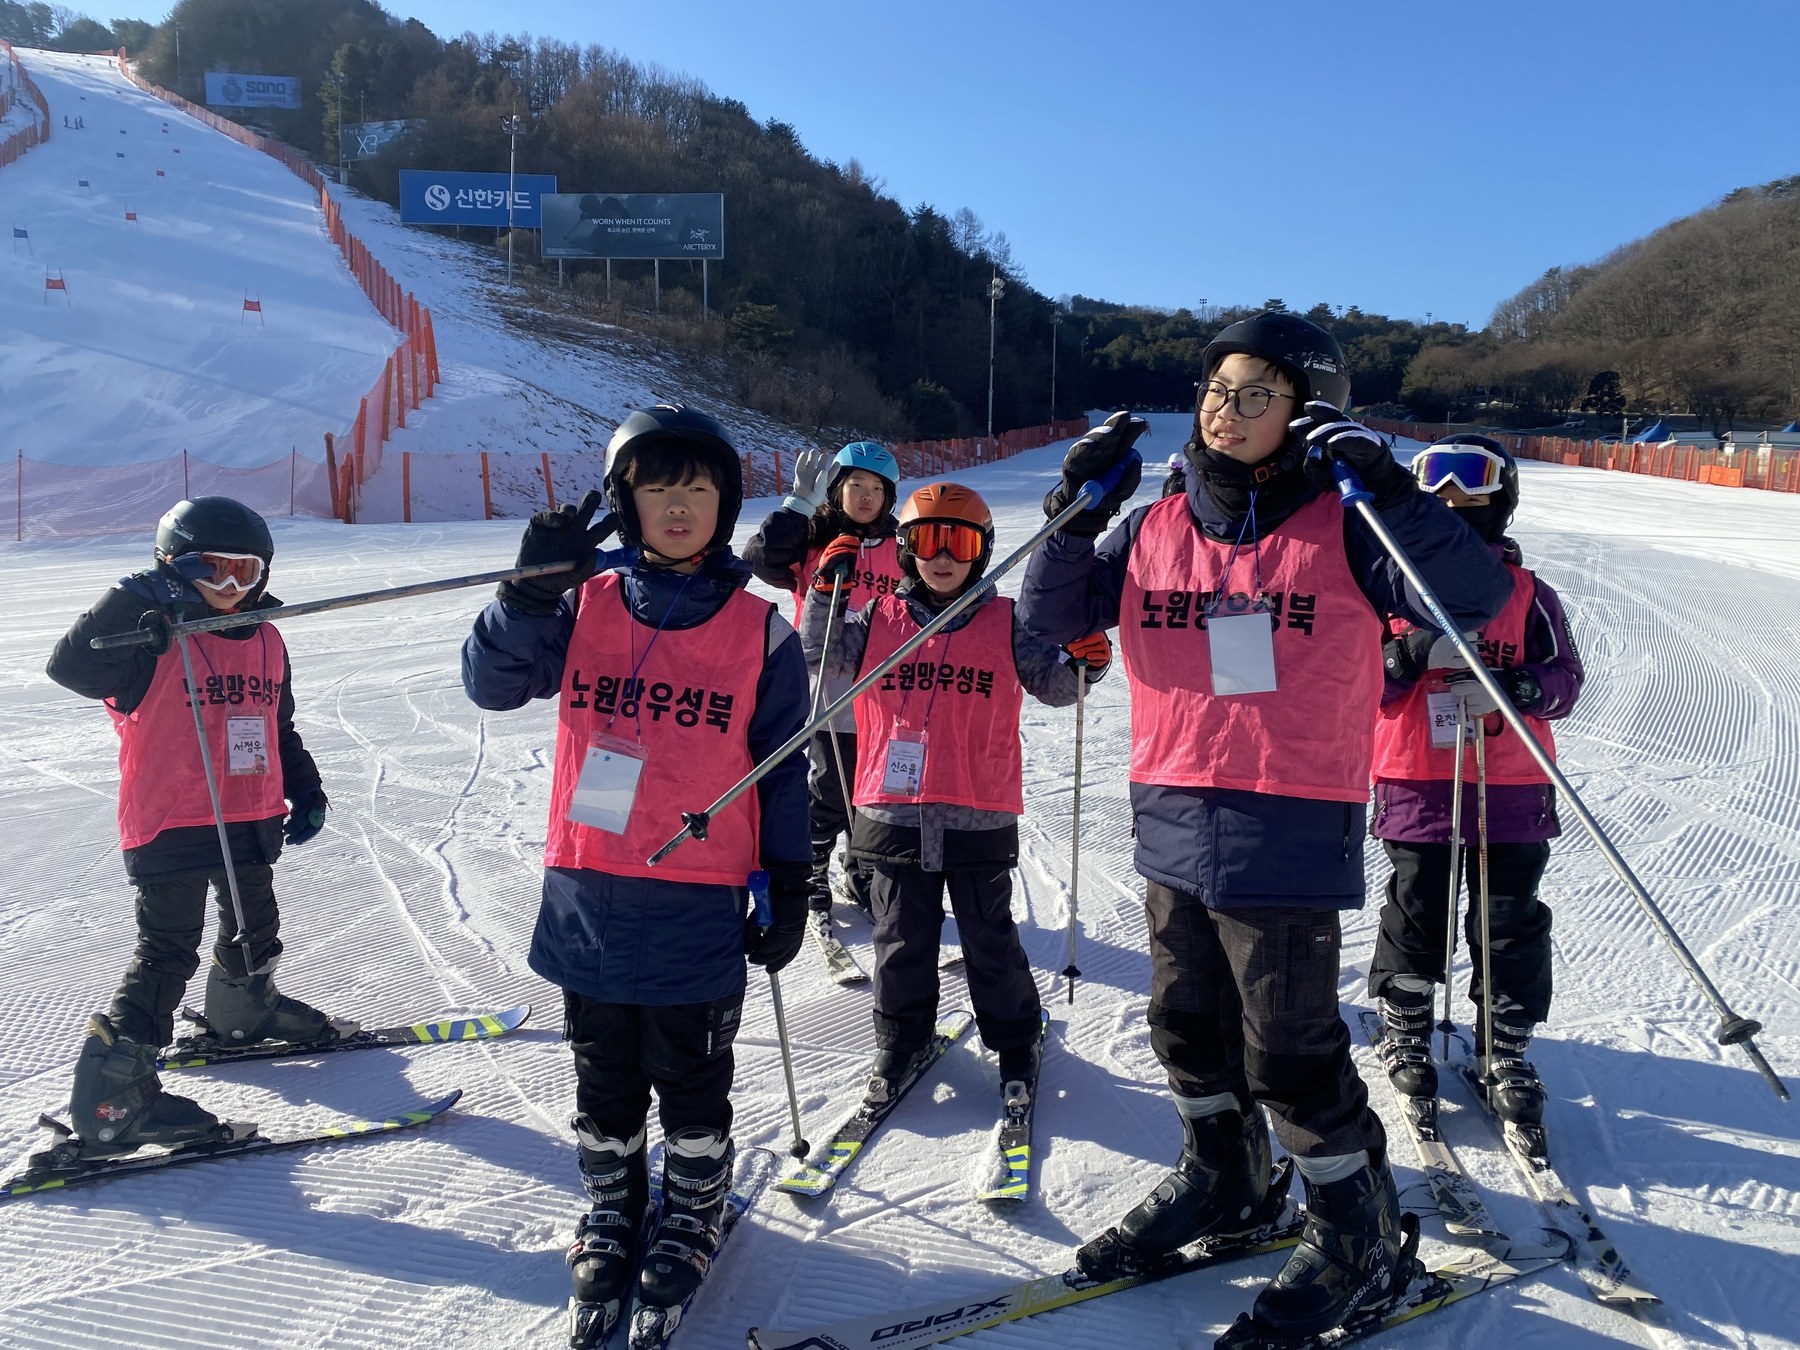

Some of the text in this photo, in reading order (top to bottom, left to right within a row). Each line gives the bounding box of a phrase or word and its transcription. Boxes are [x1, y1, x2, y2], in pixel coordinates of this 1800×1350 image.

[246, 81, 286, 94] SONO
[455, 188, 532, 210] 신한카드
[570, 669, 734, 734] 노원망우성북
[233, 740, 262, 753] 서정우
[870, 1294, 1013, 1342] XPRO
